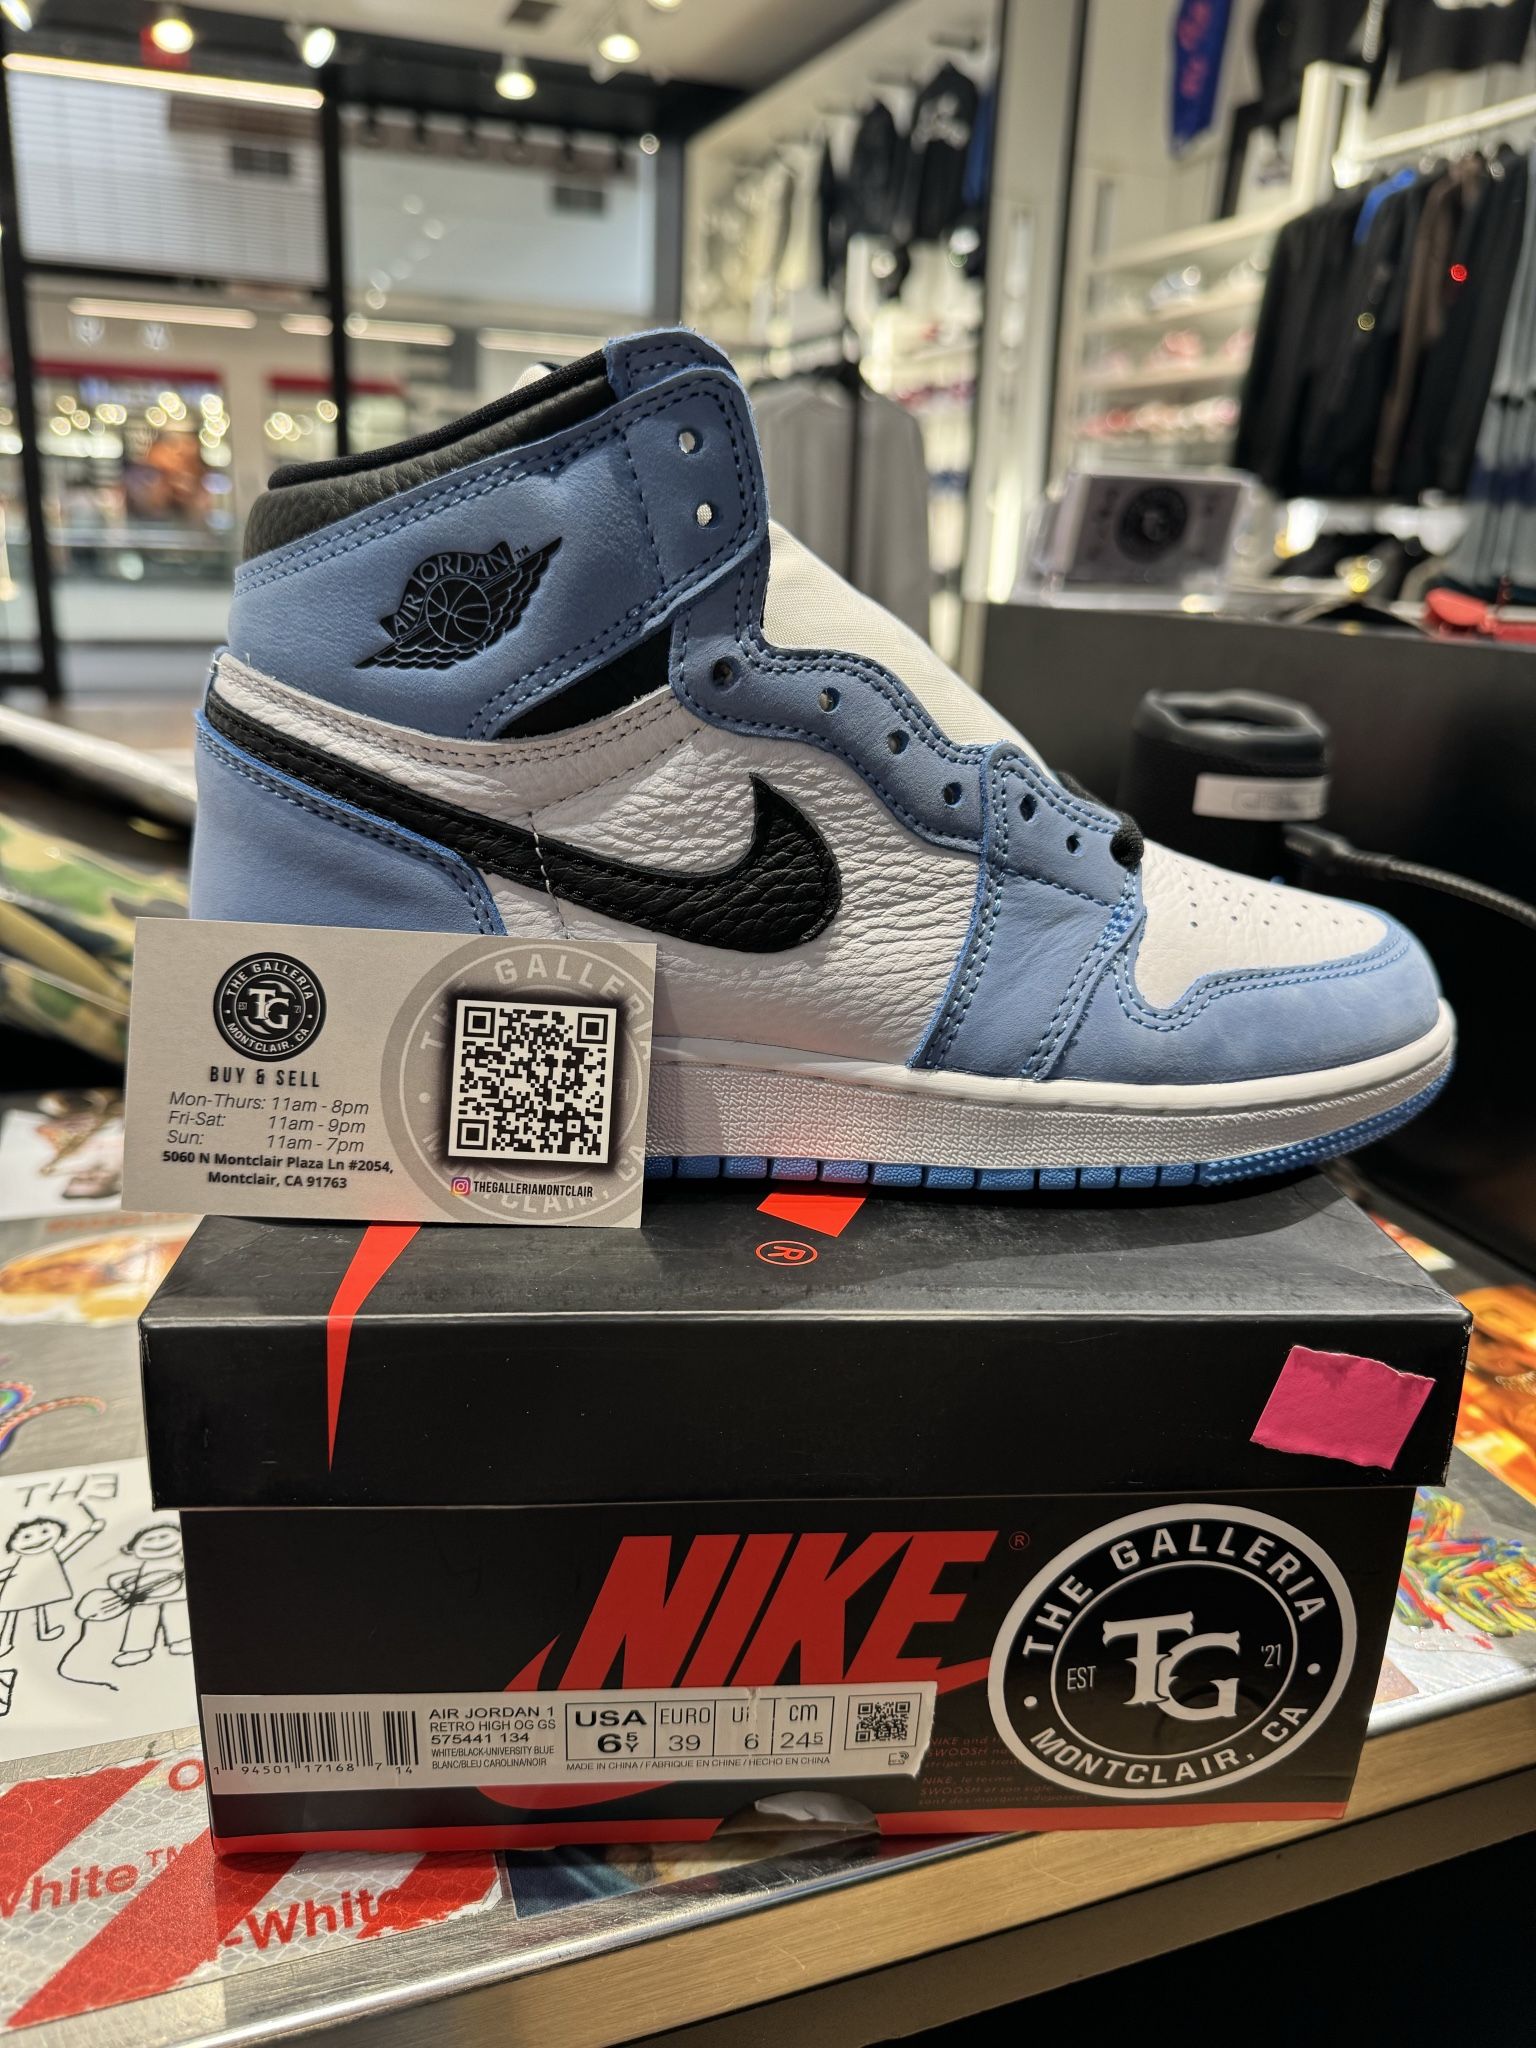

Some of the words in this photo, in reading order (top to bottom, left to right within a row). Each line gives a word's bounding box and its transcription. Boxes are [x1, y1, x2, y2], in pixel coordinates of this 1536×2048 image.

[393, 594, 425, 634] AIR
[412, 547, 510, 588] JORDAN
[226, 971, 248, 996] THE
[252, 961, 315, 1000] GALLERIA
[294, 1028, 310, 1042] CA
[210, 1065, 245, 1084] BUY
[256, 1068, 265, 1085] &
[276, 1069, 320, 1088] SELL
[169, 1091, 266, 1110] Mon-Thurs:
[272, 1096, 318, 1112] 11am
[331, 1099, 369, 1117] 8pm
[167, 1110, 227, 1128] Fri-Sat:
[268, 1115, 314, 1131] 11am
[328, 1118, 366, 1136] 9pm
[167, 1129, 204, 1145] Sun:
[267, 1134, 313, 1150] 11am
[326, 1137, 365, 1155] 7pm
[162, 1150, 196, 1163] 5060
[199, 1152, 210, 1164] N
[214, 1153, 284, 1168] Montclair
[287, 1156, 324, 1170] Plaza
[328, 1158, 345, 1170] Ln
[348, 1159, 394, 1175] #2054,
[208, 1171, 281, 1187] Montclair,
[284, 1175, 304, 1187] CA
[307, 1176, 348, 1189] 91763
[473, 1179, 594, 1198] THEGALLERIAMONTCLAIR
[1022, 1574, 1095, 1659] THE
[1108, 1523, 1328, 1623] GALLERIA
[557, 1530, 999, 1691] NIKE
[1101, 1610, 1242, 1722] TG
[1066, 1664, 1097, 1692] EST
[429, 1708, 460, 1720] AIR
[465, 1706, 540, 1719] JORDAN
[547, 1705, 554, 1717] 1
[575, 1709, 647, 1727] USA
[660, 1707, 711, 1725] EURO
[789, 1704, 818, 1723] cm
[1261, 1703, 1309, 1744] CA
[430, 1721, 475, 1732] RETRO
[479, 1720, 511, 1731] HIGH
[514, 1719, 534, 1730] OG
[538, 1719, 556, 1730] GS
[431, 1733, 492, 1745] 575441
[500, 1732, 530, 1743] 134
[668, 1735, 701, 1752] 39
[744, 1733, 760, 1750] 6
[431, 1746, 532, 1757] WHITE/BLACK-UNIVERSITY
[533, 1745, 555, 1755] BLUE
[213, 1766, 220, 1775] 1
[241, 1765, 291, 1775] 94501
[304, 1763, 355, 1773] 17168
[374, 1762, 383, 1771] 7
[396, 1765, 412, 1775] 14
[432, 1759, 481, 1769] BLANC/BLEU
[483, 1758, 547, 1768] CAROLINA/NOIR
[566, 1762, 595, 1771] MADE
[597, 1761, 606, 1770] IN
[608, 1761, 639, 1770] CHINA
[645, 1759, 694, 1769] FABRIQUE
[696, 1759, 709, 1768] EN
[711, 1758, 741, 1768] CHINE
[748, 1757, 782, 1767] HECHO
[785, 1757, 798, 1766] EN
[799, 1756, 831, 1766] CHINA
